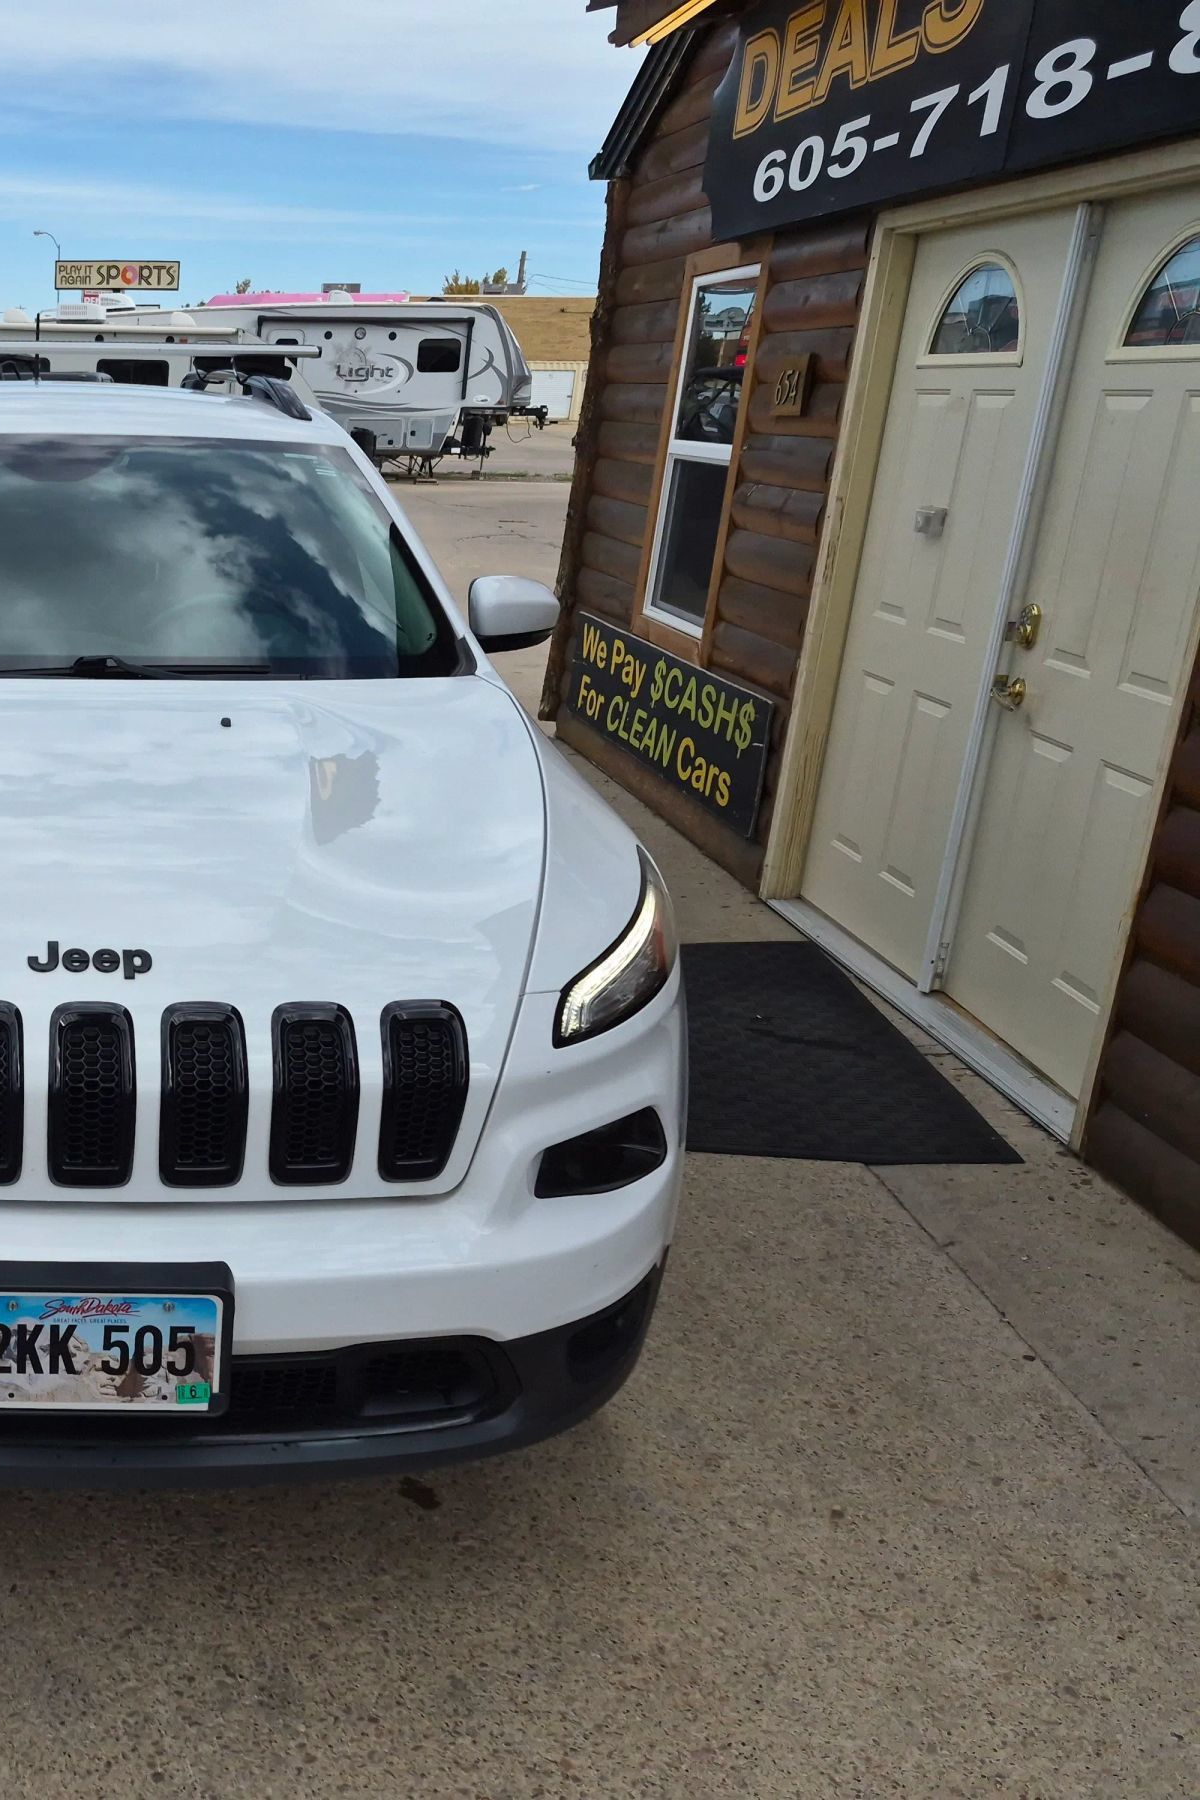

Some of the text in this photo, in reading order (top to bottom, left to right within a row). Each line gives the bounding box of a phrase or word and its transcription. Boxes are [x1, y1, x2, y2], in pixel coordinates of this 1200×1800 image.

[58, 264, 177, 286] PLAY IT SPORTS
[60, 275, 92, 285] AGAIN
[336, 362, 395, 383] Light
[774, 368, 801, 407] 654
[582, 622, 756, 759] We Pay $CASH$
[577, 674, 732, 808] For CLEAN Cars
[27, 940, 153, 980] Jeep
[101, 1325, 197, 1377] 505
[189, 1385, 197, 1398] 6
